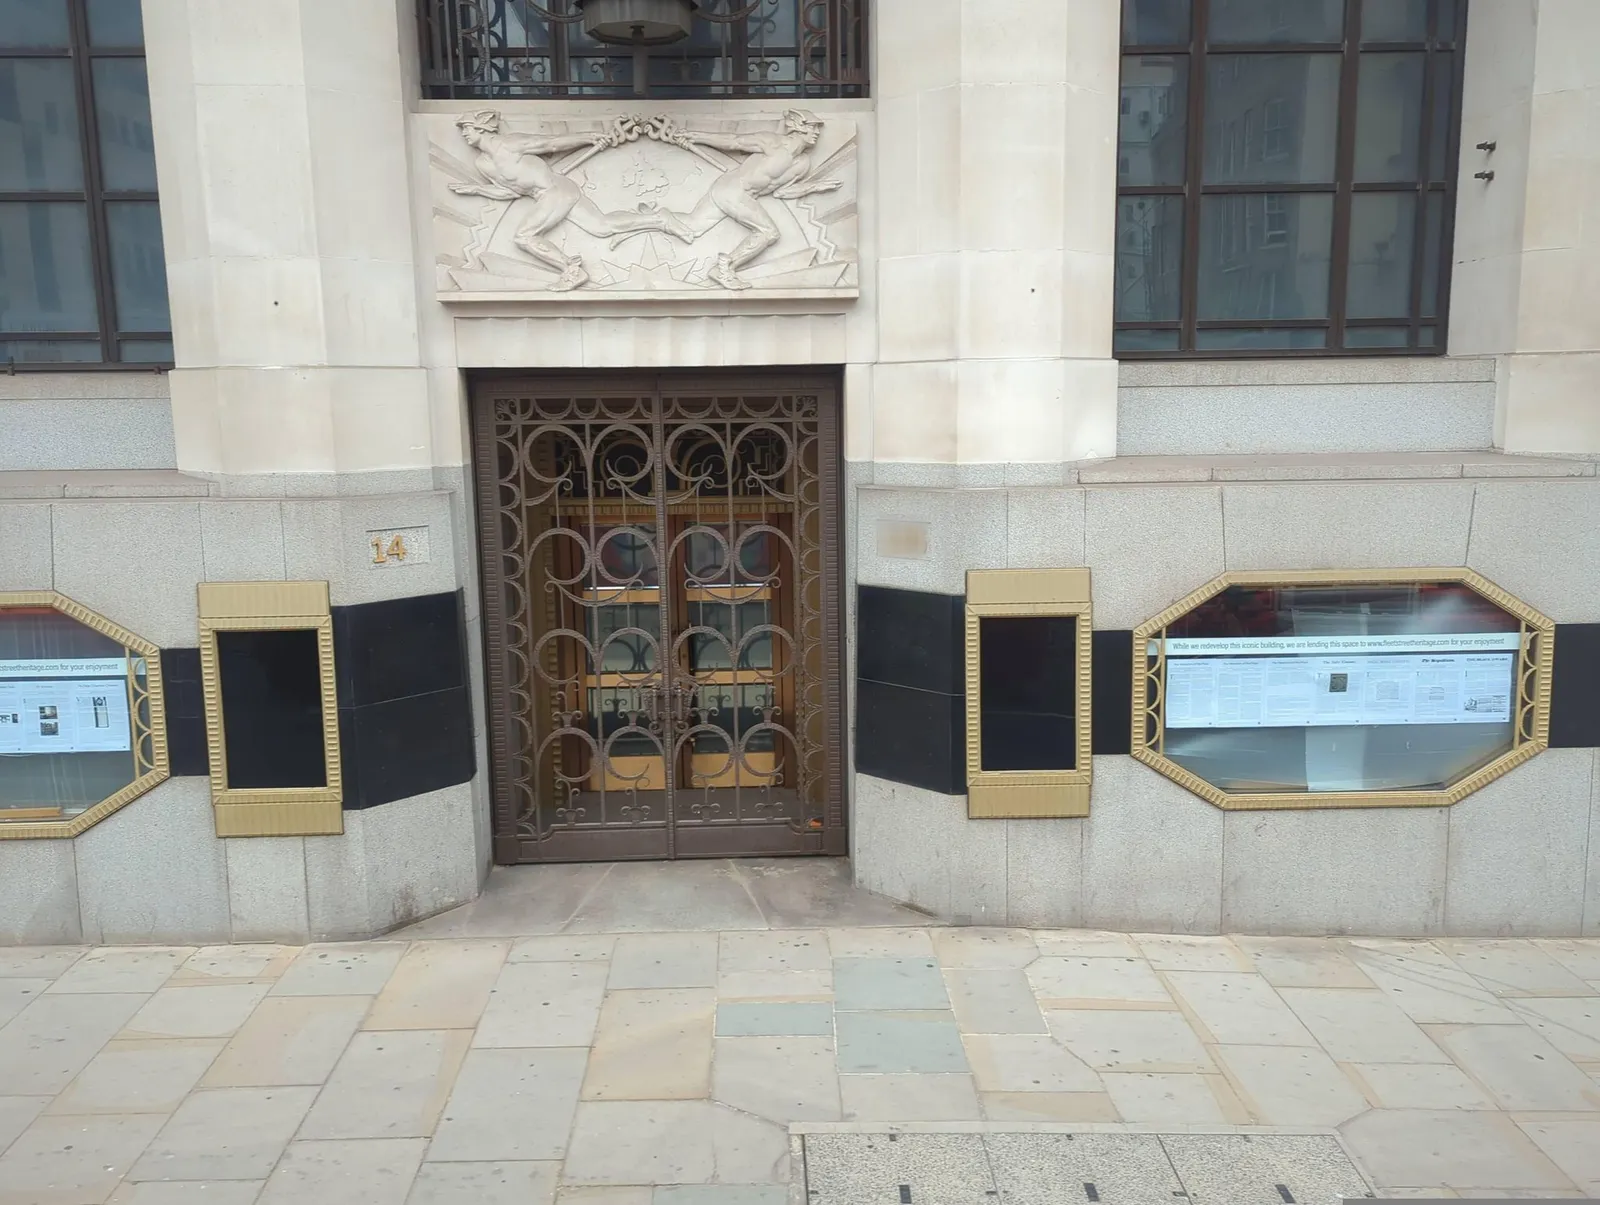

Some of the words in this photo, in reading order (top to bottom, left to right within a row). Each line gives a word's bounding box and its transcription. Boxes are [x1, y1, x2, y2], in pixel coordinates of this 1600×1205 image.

[370, 534, 408, 563] 14
[1172, 641, 1189, 650] While
[1200, 641, 1229, 651] redevelop
[1230, 641, 1241, 649] this
[1241, 641, 1259, 649] iconic
[1260, 640, 1285, 650] building,
[1307, 640, 1329, 649] lending
[1330, 640, 1341, 648] this
[1342, 641, 1359, 649] space
[1450, 637, 1458, 645] for
[1474, 637, 1505, 646] enjoyment
[60, 663, 69, 671] for
[70, 664, 84, 672] your
[85, 662, 119, 671] enjoyment
